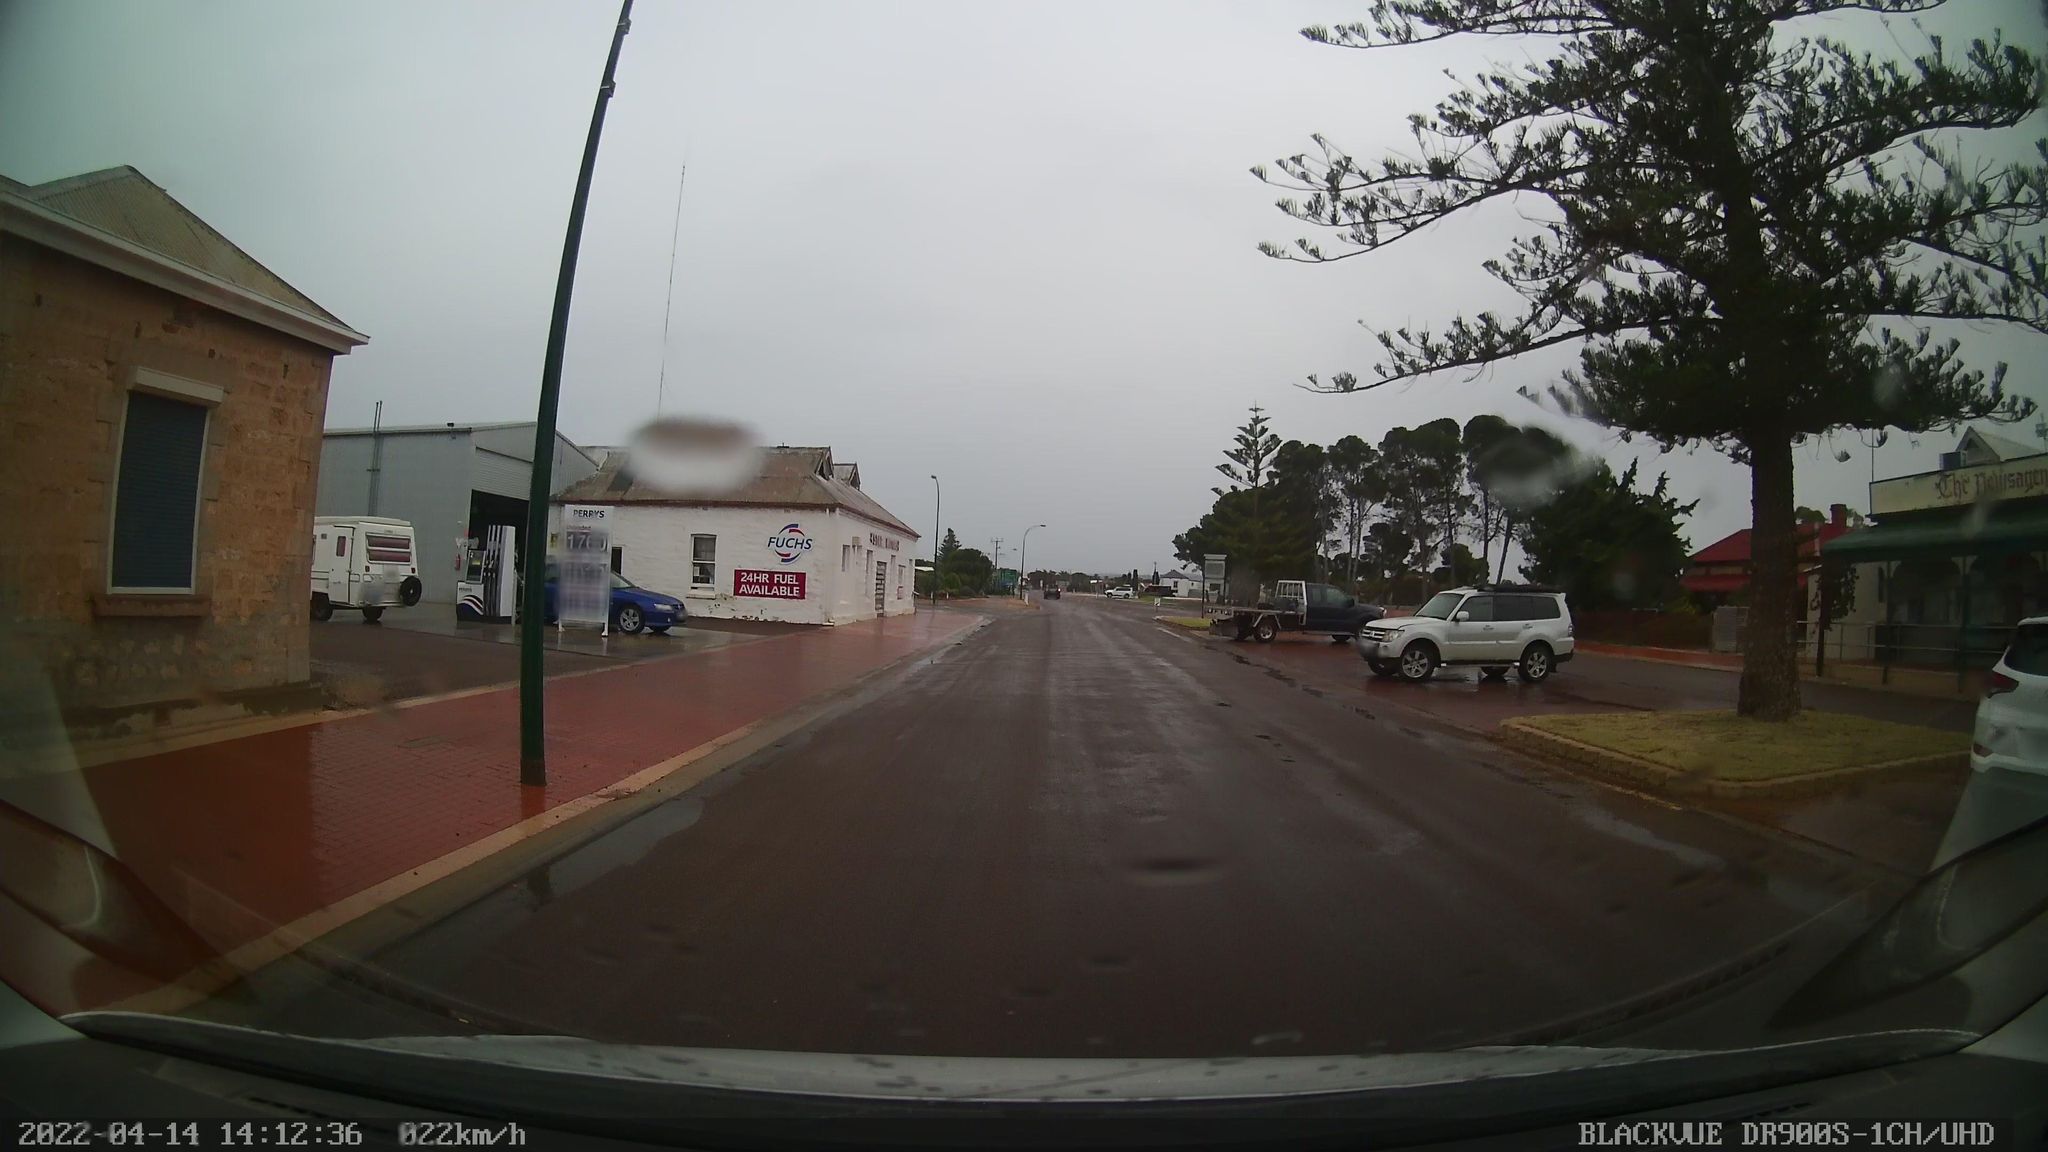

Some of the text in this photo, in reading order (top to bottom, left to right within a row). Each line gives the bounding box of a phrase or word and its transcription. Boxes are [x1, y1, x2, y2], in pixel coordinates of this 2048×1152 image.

[1935, 472, 1970, 499] The
[573, 510, 605, 518] PERRYS
[767, 536, 813, 550] FUCHS
[741, 572, 799, 585] 24HR FUEL
[739, 585, 800, 597] AVAILABLE
